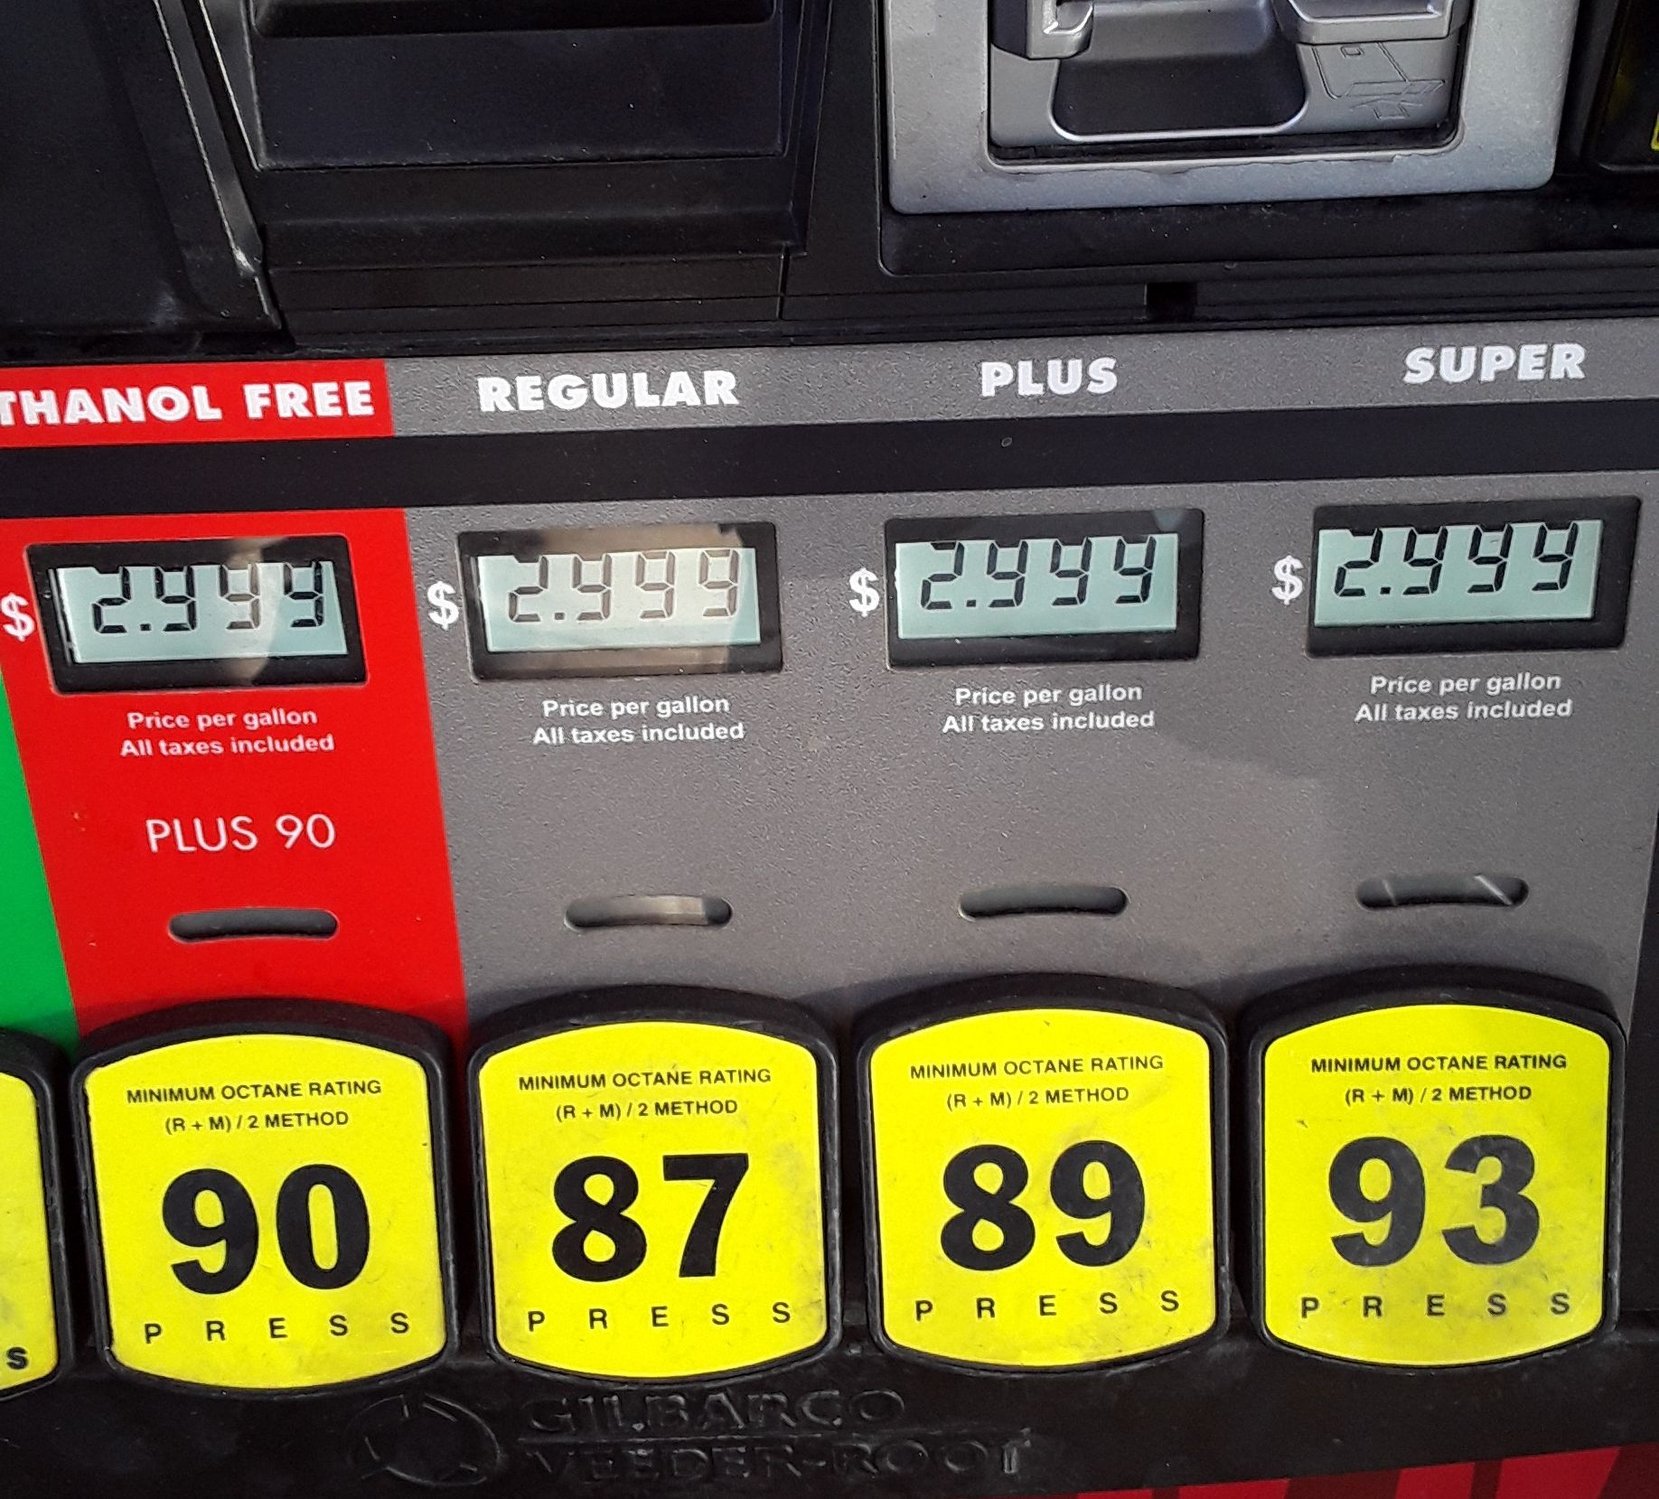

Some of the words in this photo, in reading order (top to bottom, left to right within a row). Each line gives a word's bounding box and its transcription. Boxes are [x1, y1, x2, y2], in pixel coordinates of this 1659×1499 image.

[980, 357, 1118, 398] PLUS
[1402, 342, 1586, 384] SUPER
[243, 381, 375, 419] FREE
[476, 369, 740, 413] REGULAR
[847, 566, 882, 618] $
[1270, 554, 1305, 606] $
[0, 592, 36, 642] $
[426, 580, 460, 631] $
[955, 686, 1017, 706] Price
[1023, 688, 1063, 709] per
[1068, 683, 1142, 708] gallon
[1370, 675, 1432, 695] Price
[1439, 677, 1481, 697] per
[1486, 671, 1562, 696] gallon
[126, 711, 190, 730] Price
[196, 713, 237, 732] per
[242, 707, 318, 731] gallon
[541, 699, 604, 718] Price
[610, 701, 650, 720] per
[656, 695, 730, 719] gallon
[942, 714, 975, 734] All
[980, 714, 1045, 733] taxes
[1051, 710, 1155, 730] included
[1354, 703, 1387, 722] All
[1394, 703, 1459, 722] taxes
[1467, 698, 1573, 719] included
[120, 739, 153, 757] All
[158, 739, 225, 756] taxes
[230, 733, 335, 754] included
[532, 726, 566, 745] All
[570, 727, 635, 744] taxes
[641, 721, 746, 742] included
[145, 815, 258, 853] PLUS
[275, 813, 336, 849] 90
[910, 1061, 997, 1079] MINIMUM
[1003, 1058, 1084, 1076] OCTANE
[1090, 1055, 1164, 1072] RATING
[1311, 1056, 1401, 1073] MINIMUM
[1406, 1055, 1488, 1071] OCTANE
[1494, 1054, 1567, 1070] RATING
[126, 1086, 215, 1104] MINIMUM
[220, 1082, 303, 1100] OCTANE
[308, 1079, 382, 1096] RATING
[518, 1073, 606, 1091] MINIMUM
[612, 1071, 693, 1088] OCTANE
[699, 1068, 771, 1085] RATING
[1448, 1085, 1532, 1102] METHOD
[654, 1099, 738, 1117] METHOD
[1045, 1086, 1129, 1104] METHOD
[264, 1110, 349, 1129] METHOD
[940, 1139, 1146, 1272] 89
[1328, 1134, 1540, 1268] 93
[161, 1163, 371, 1295] 90
[551, 1152, 750, 1283] 87
[527, 1301, 791, 1332] PRESS
[915, 1289, 1180, 1322] PRESS
[1301, 1292, 1570, 1319] PRESS
[144, 1312, 410, 1345] PRESS
[523, 1389, 905, 1432] GILBARCO
